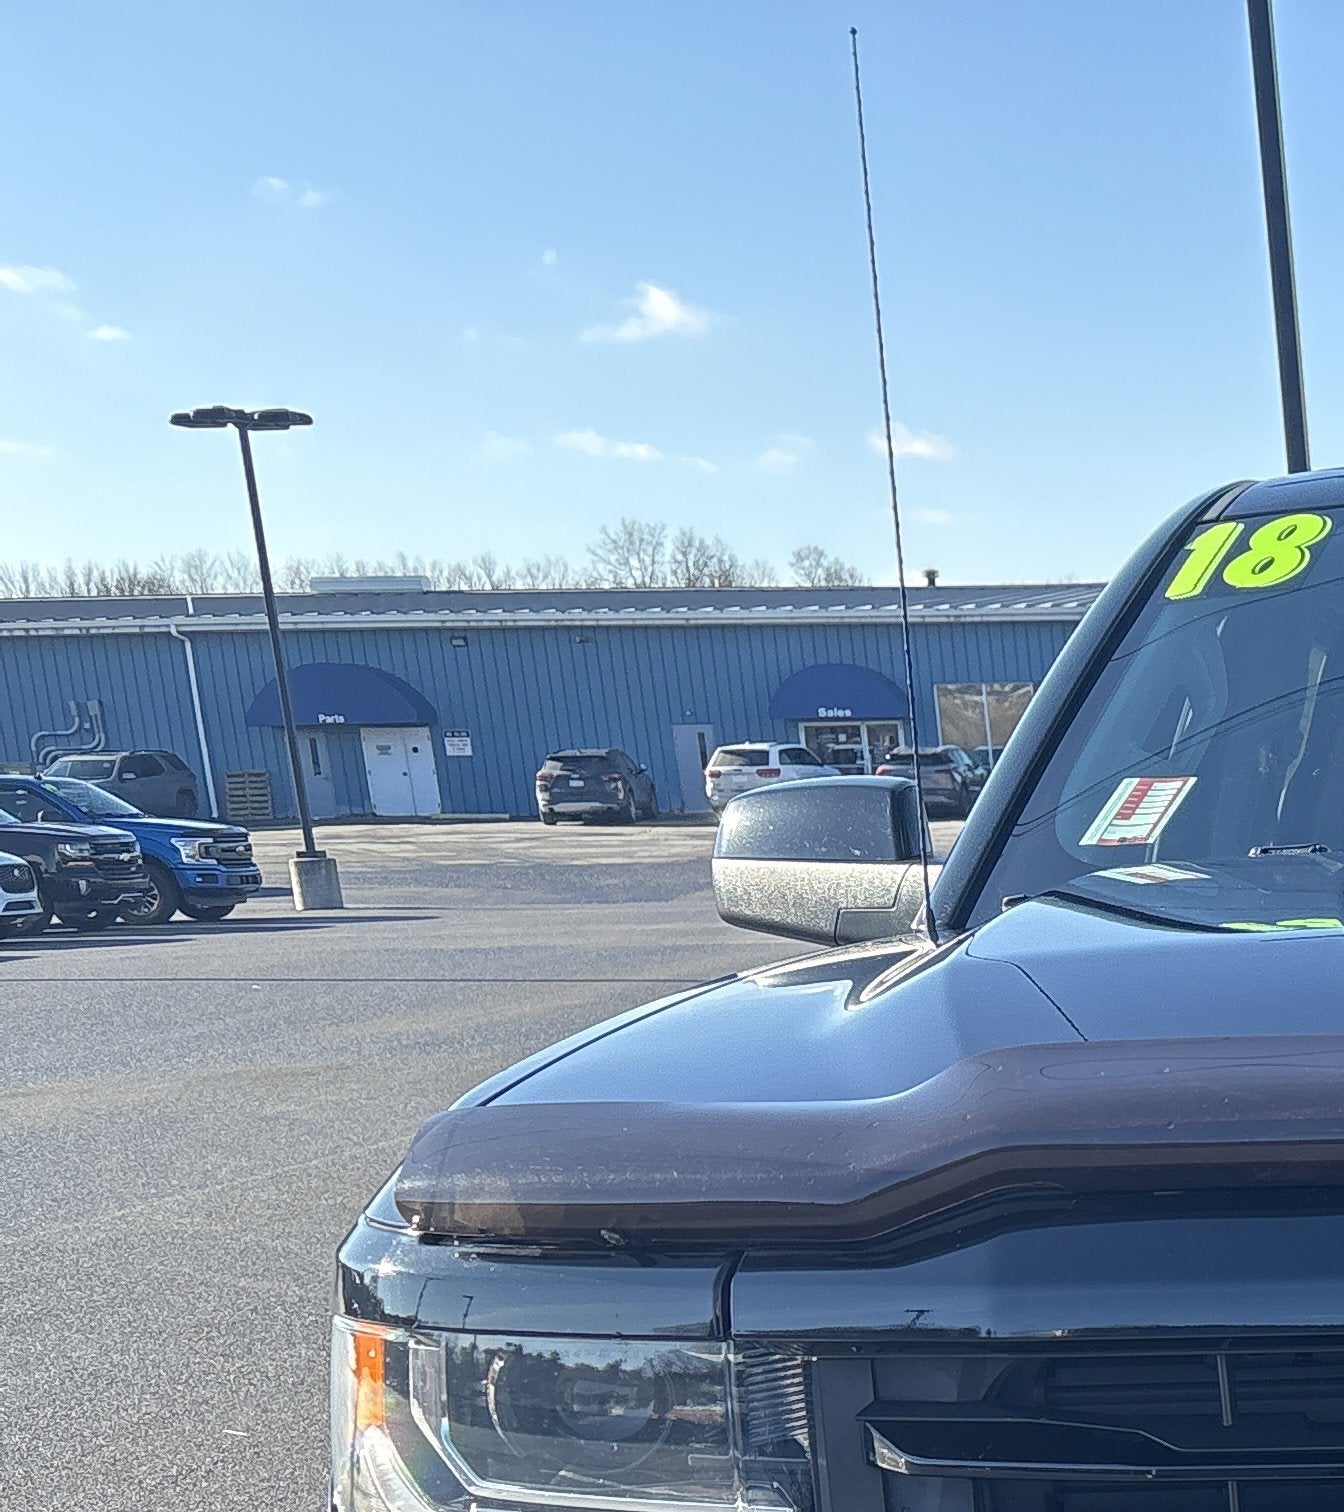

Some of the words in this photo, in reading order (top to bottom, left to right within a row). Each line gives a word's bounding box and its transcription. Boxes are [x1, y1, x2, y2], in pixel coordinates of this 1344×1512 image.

[1164, 512, 1333, 601] 18
[817, 707, 852, 718] Sales
[317, 713, 345, 724] Parts
